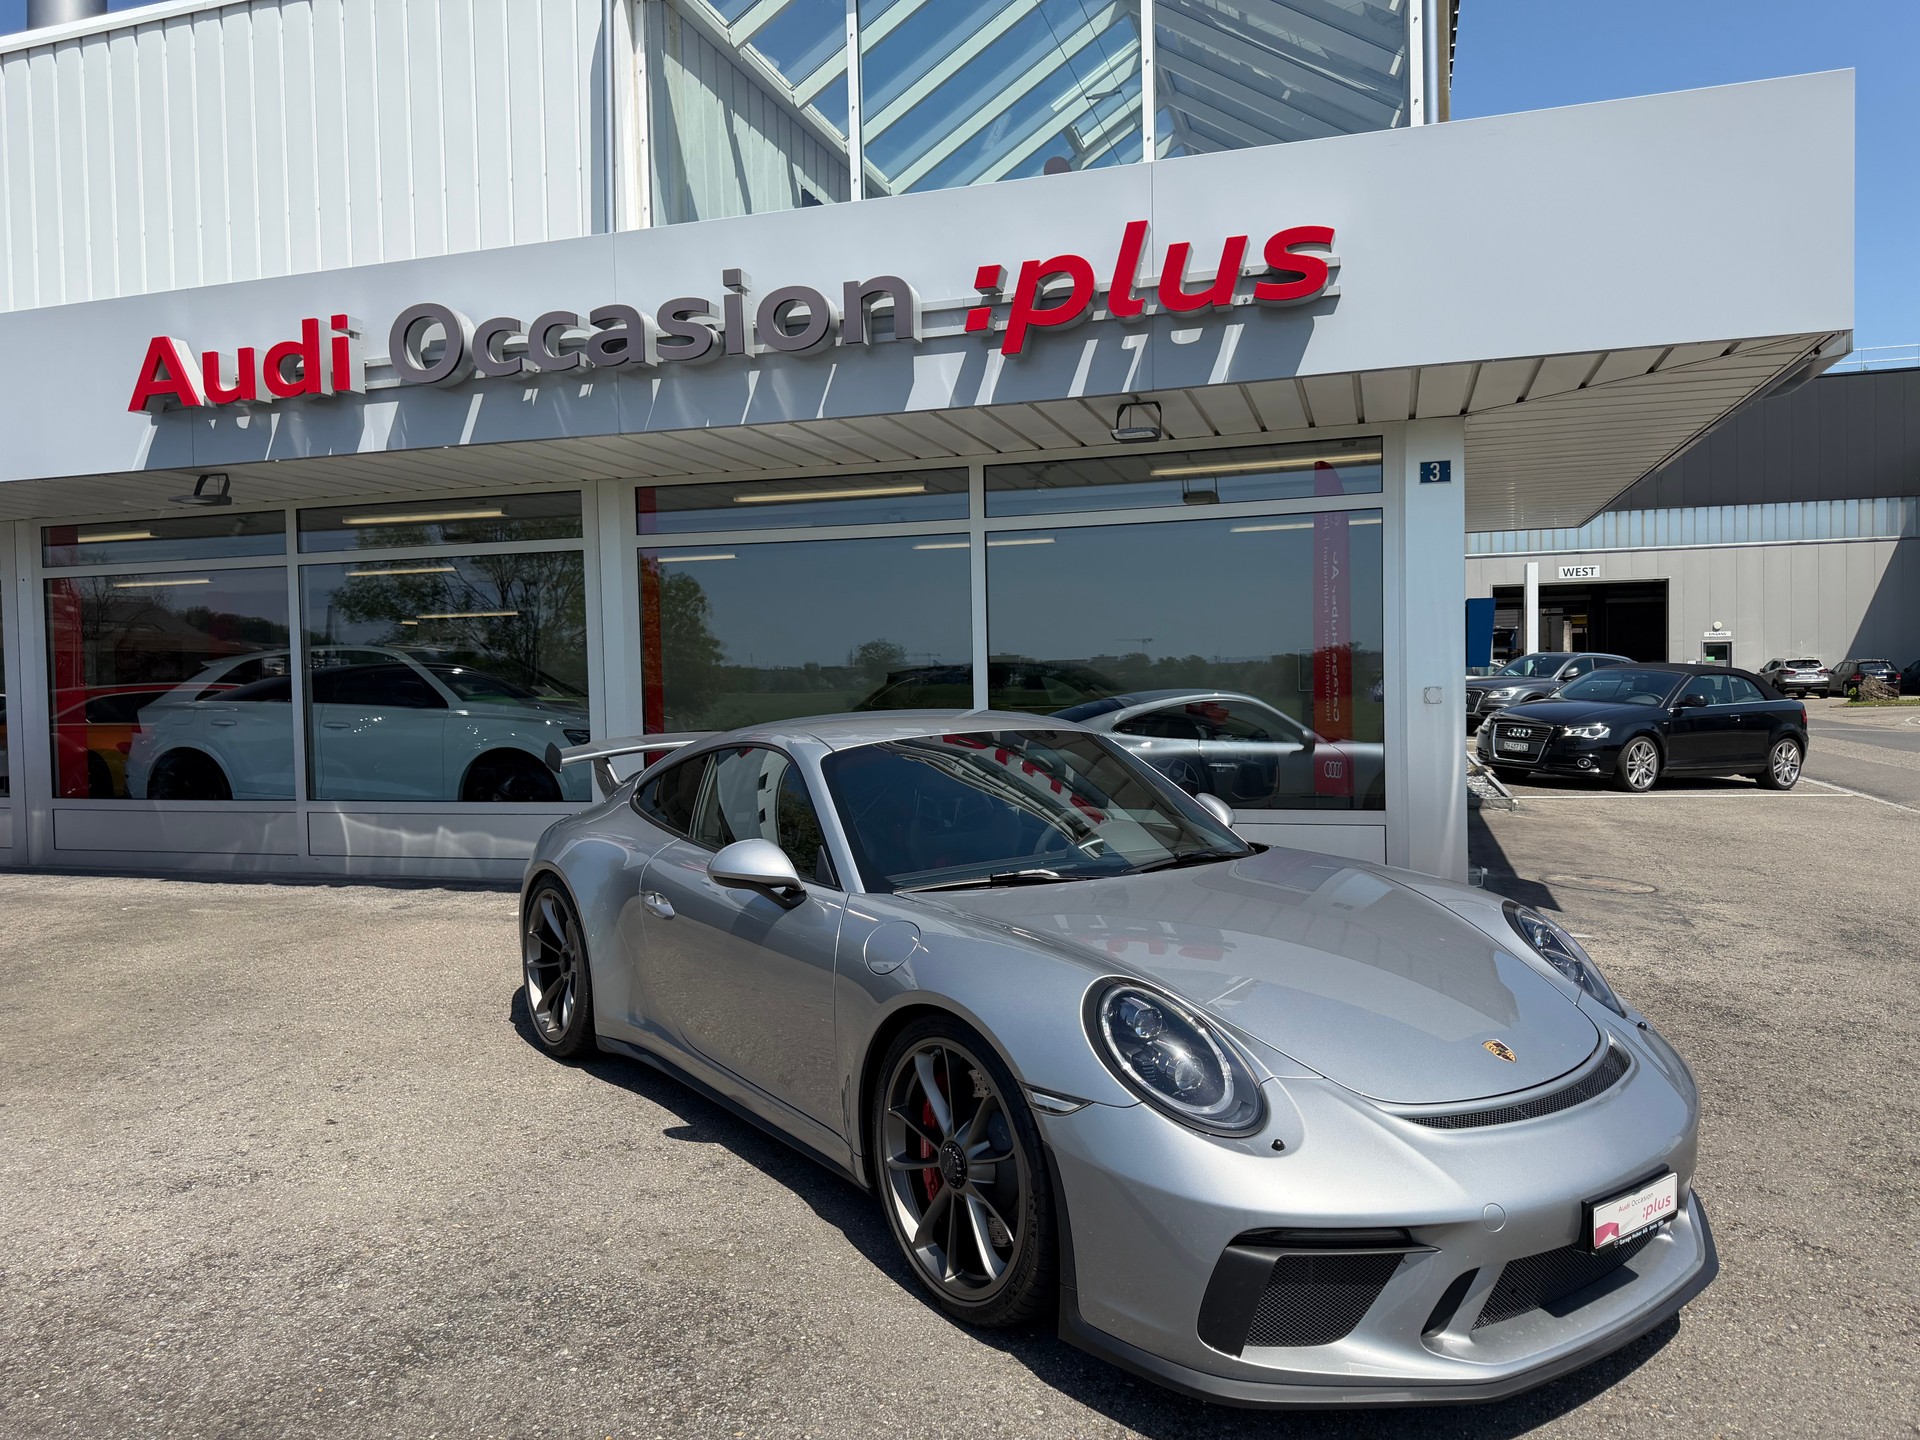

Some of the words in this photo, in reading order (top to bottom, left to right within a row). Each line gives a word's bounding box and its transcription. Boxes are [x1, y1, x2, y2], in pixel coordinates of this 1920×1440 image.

[128, 313, 353, 412] Audi
[388, 267, 918, 386] Occasion
[964, 219, 1337, 357] :plus
[1429, 462, 1440, 482] 3
[1562, 567, 1596, 577] WEST
[1618, 1203, 1631, 1213] Audi
[1631, 1192, 1654, 1207] Occasion
